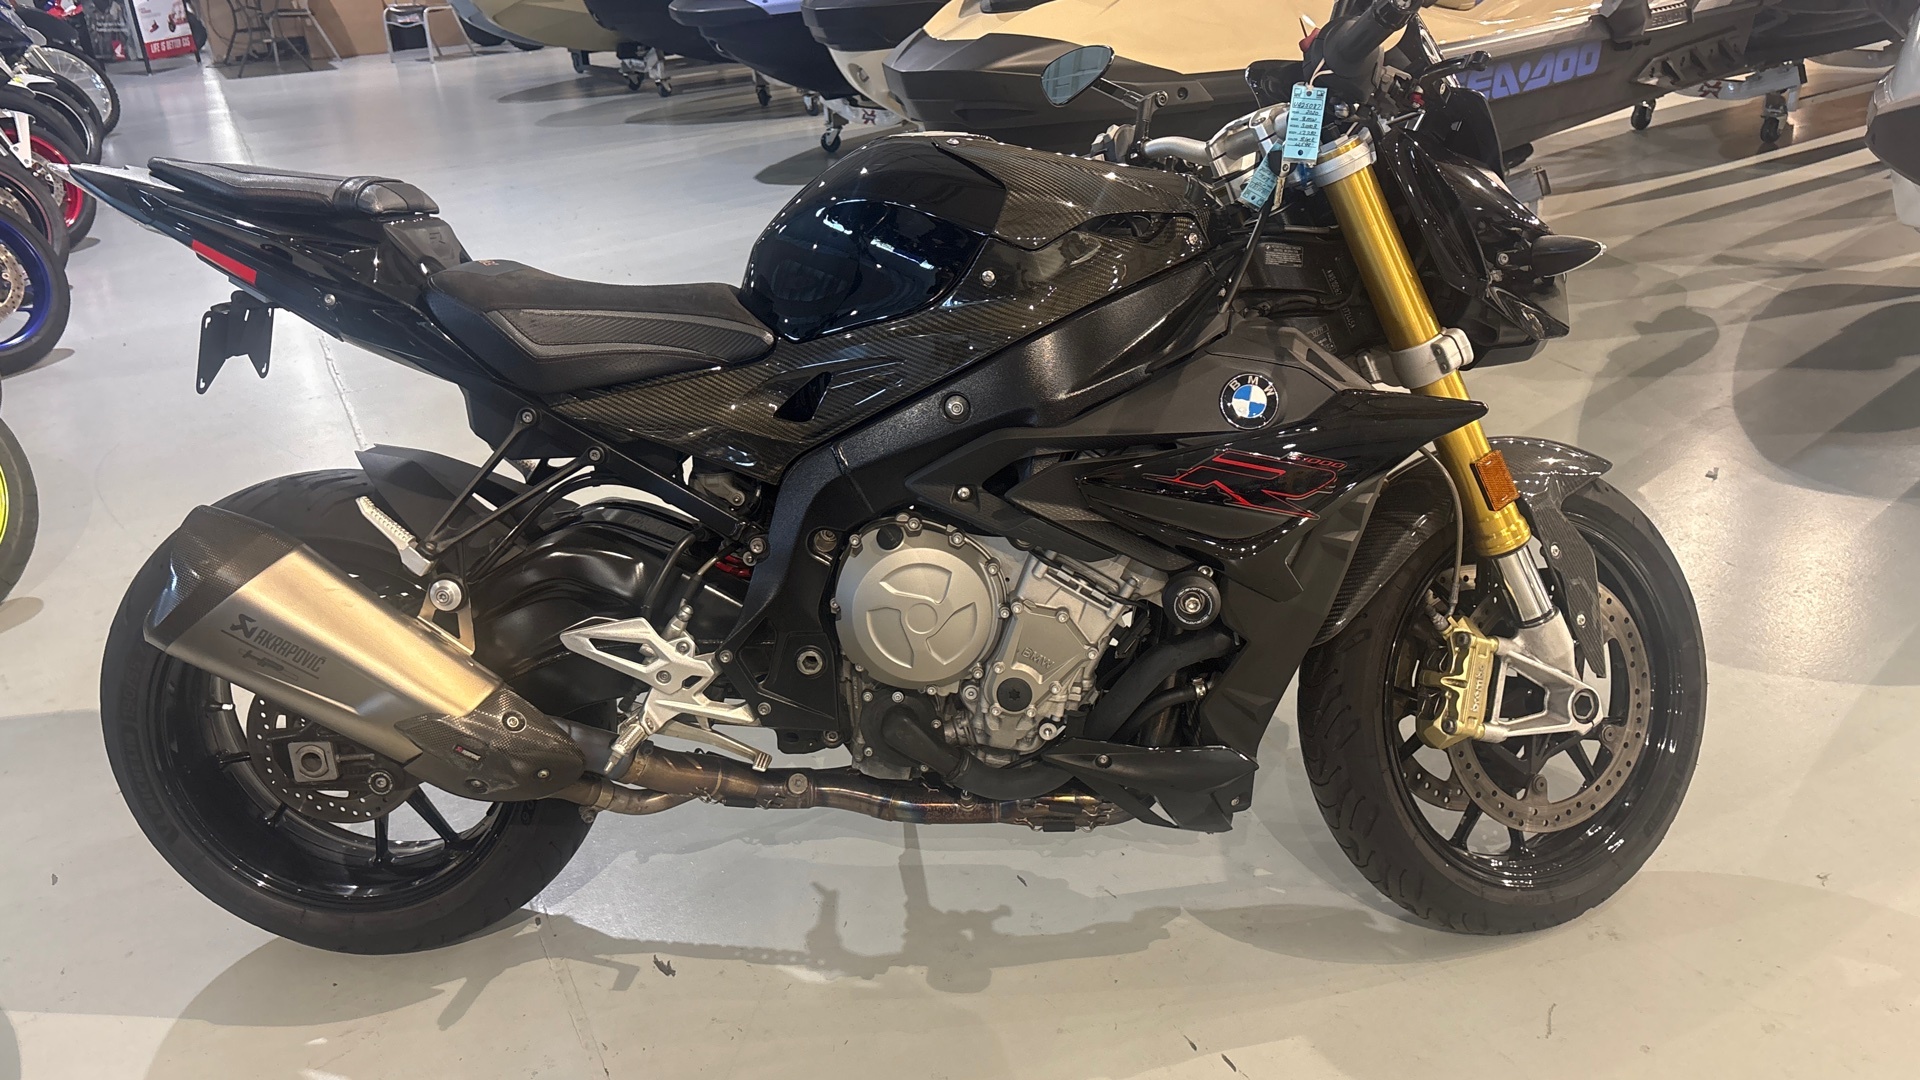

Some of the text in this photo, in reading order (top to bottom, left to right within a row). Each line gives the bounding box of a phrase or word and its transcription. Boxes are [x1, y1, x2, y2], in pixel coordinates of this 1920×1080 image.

[150, 42, 161, 54] LIFE
[161, 41, 167, 51] IS
[1229, 375, 1276, 397] BMW
[1021, 647, 1056, 669] BMW
[1470, 664, 1485, 713] brembo
